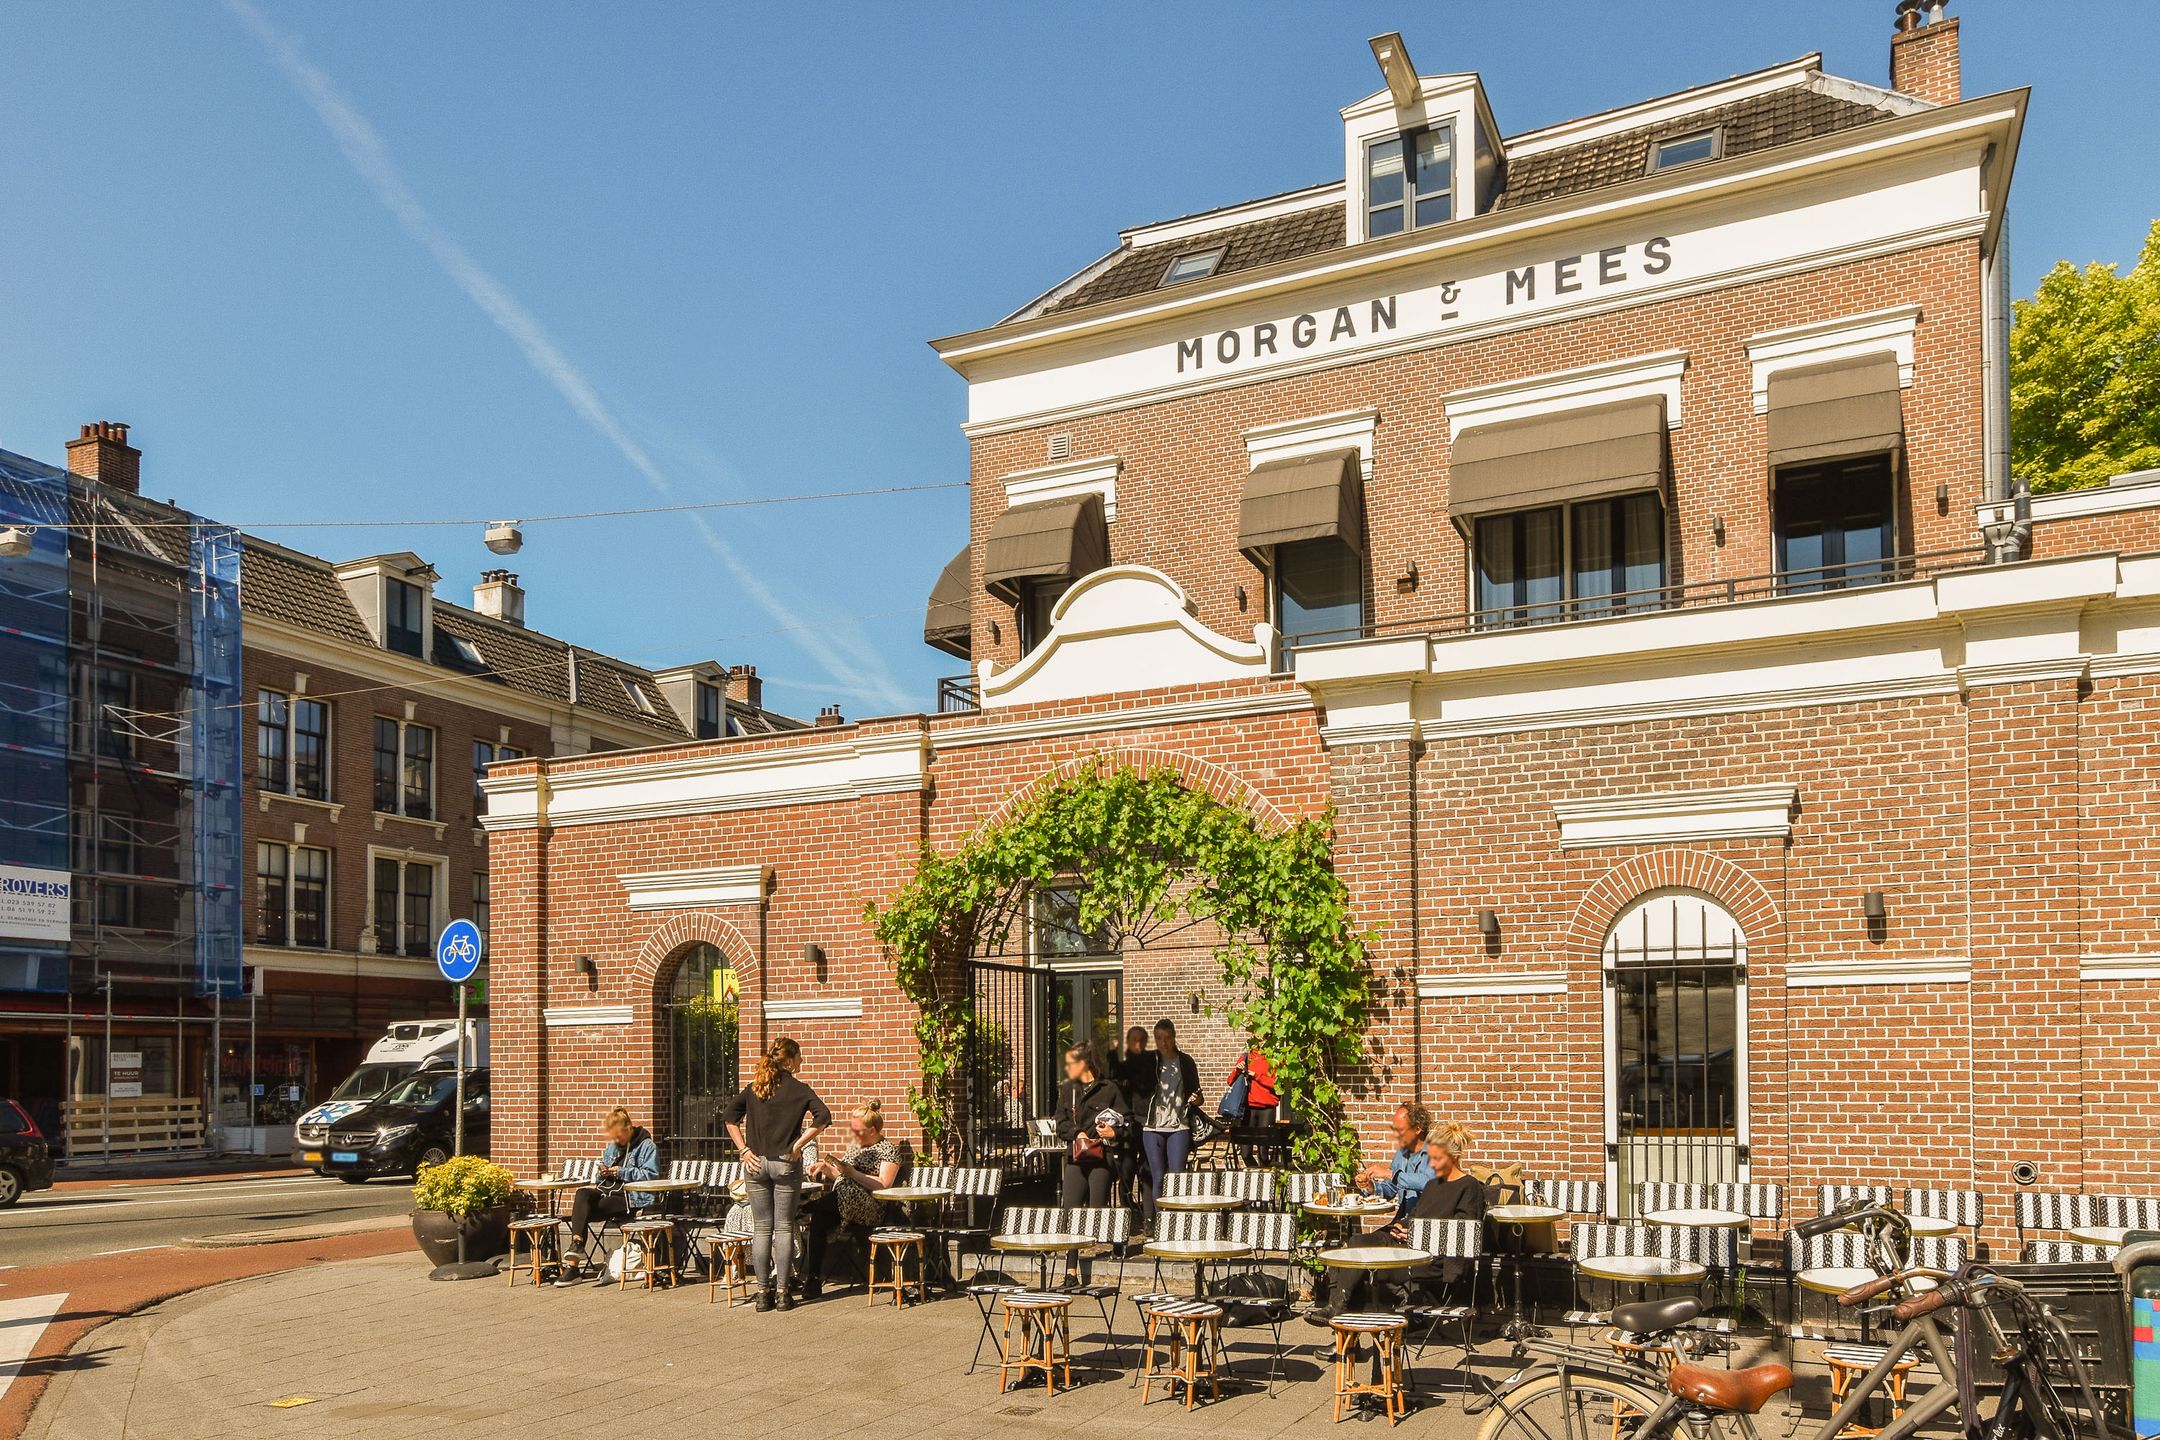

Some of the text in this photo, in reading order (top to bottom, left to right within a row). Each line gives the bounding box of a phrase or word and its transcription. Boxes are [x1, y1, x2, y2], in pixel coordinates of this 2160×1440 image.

[1177, 237, 1671, 373] MORGAN & MEES
